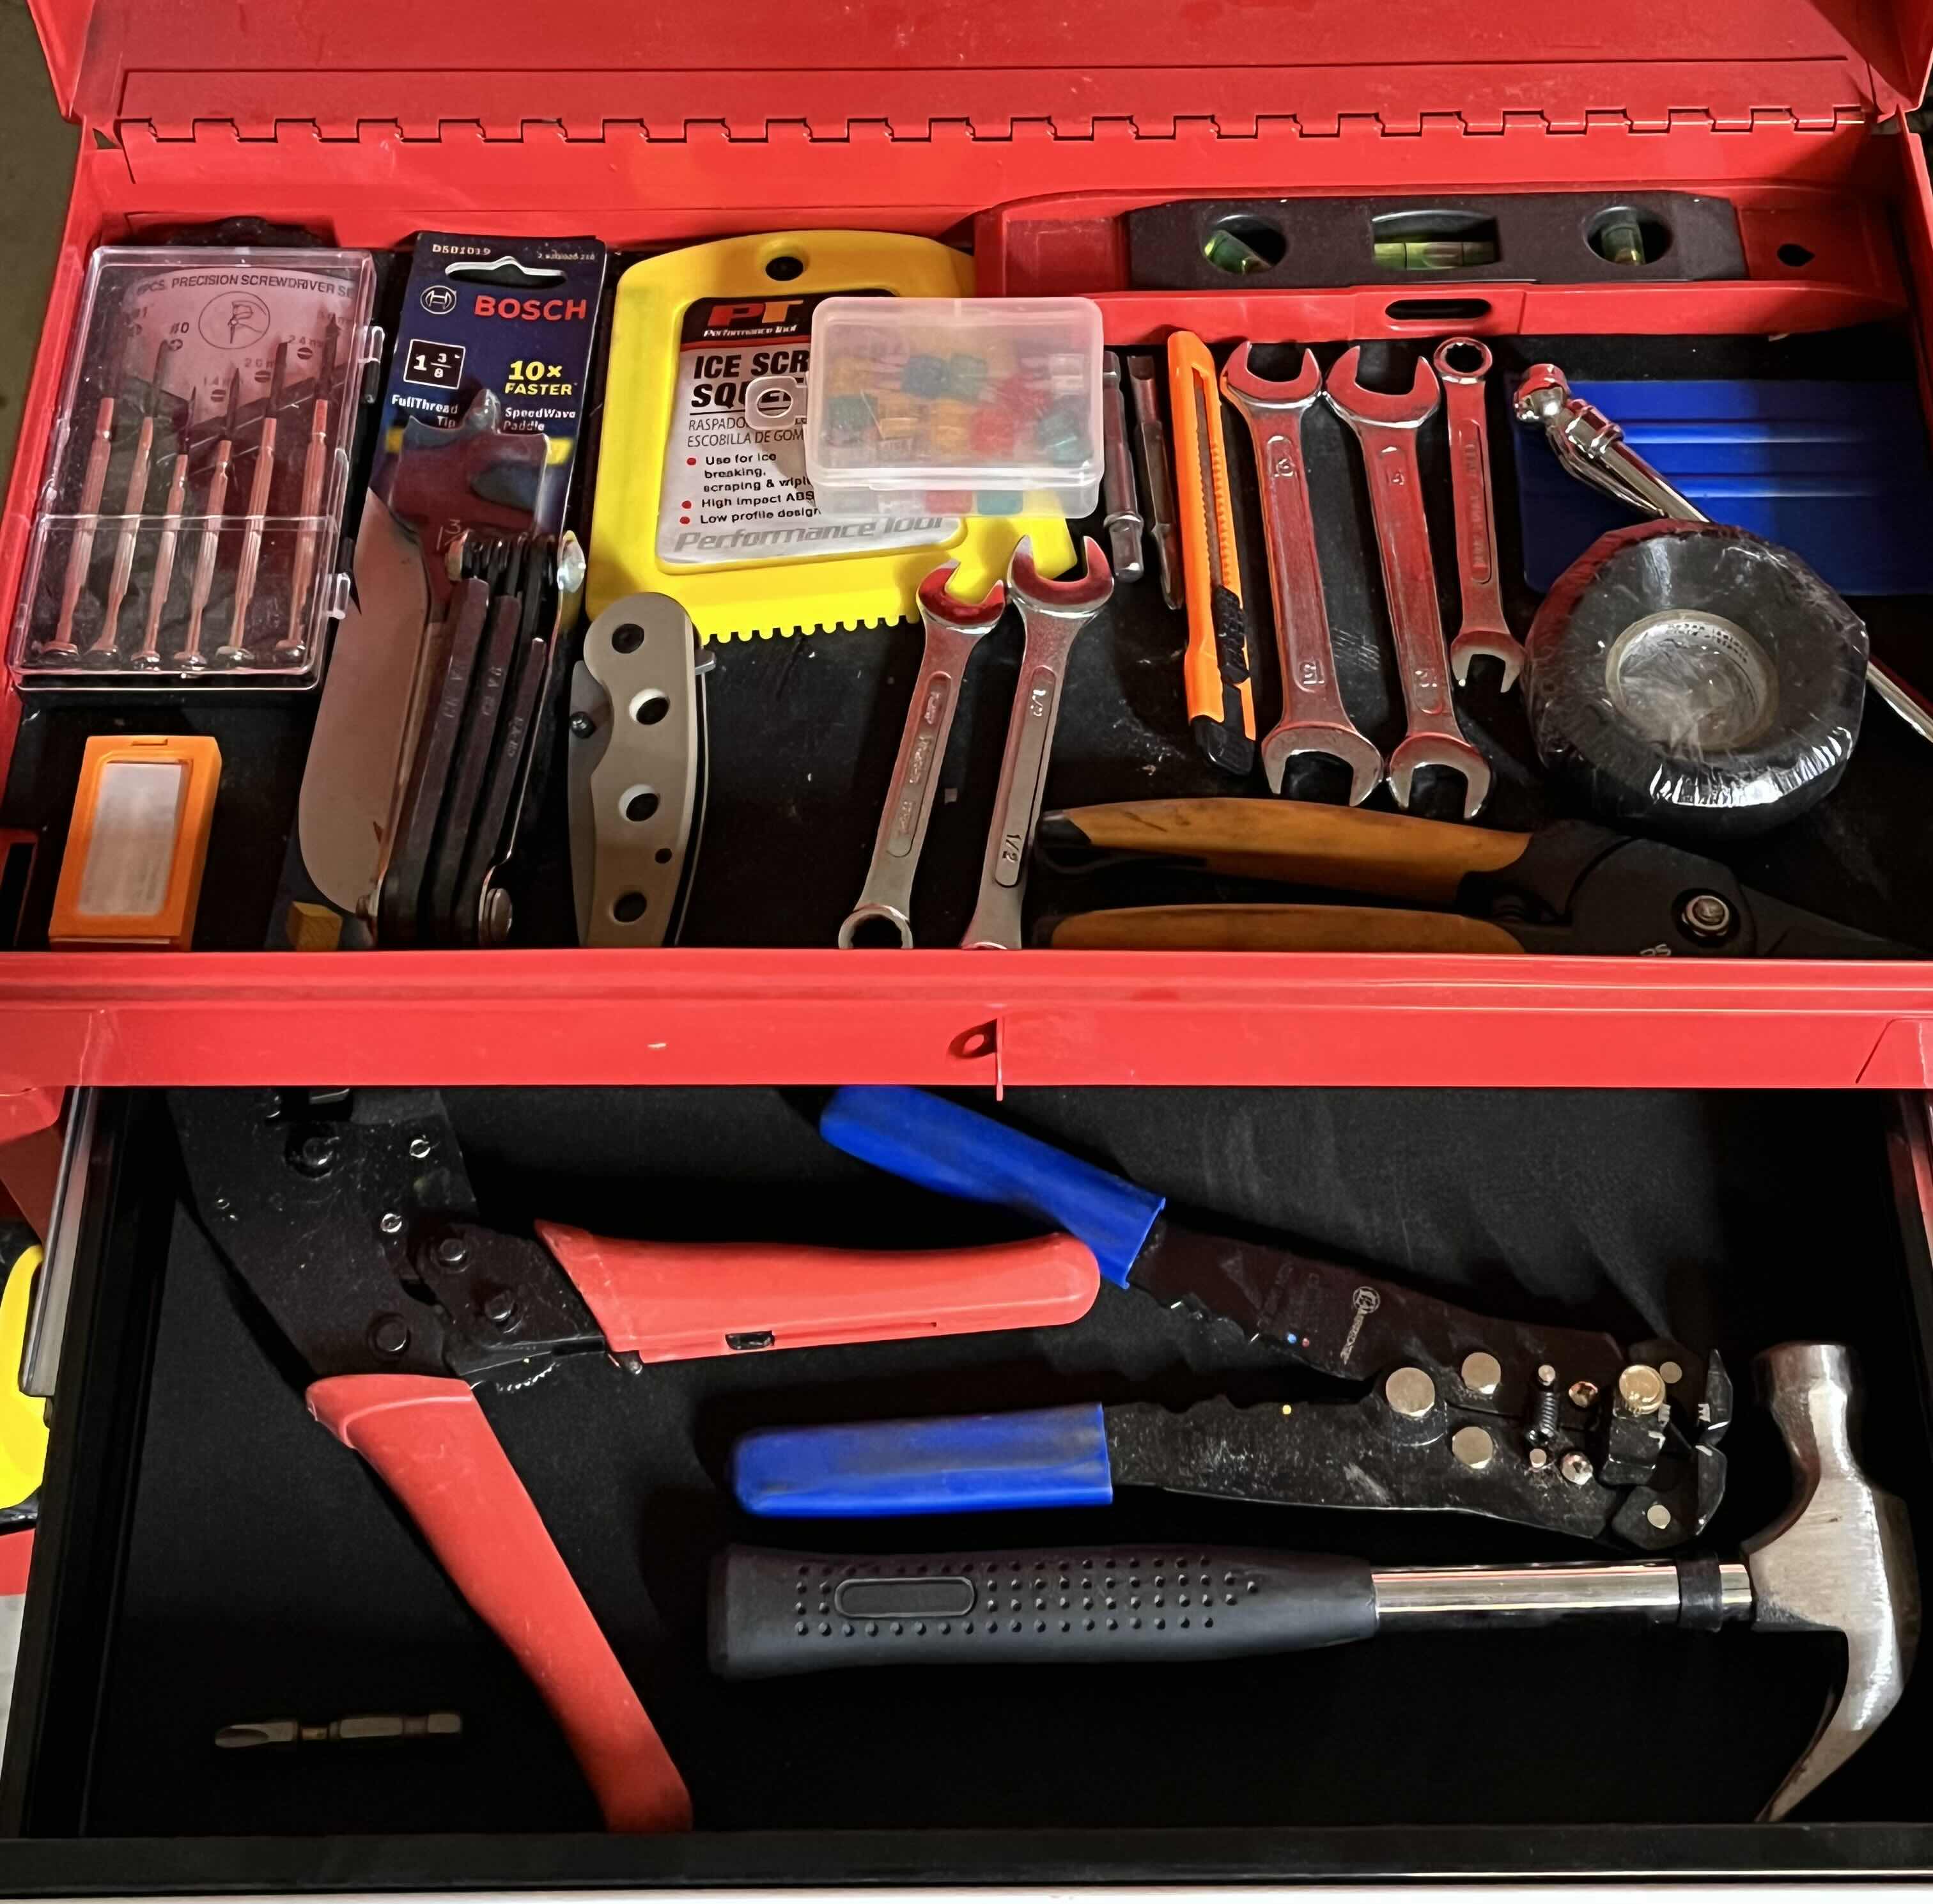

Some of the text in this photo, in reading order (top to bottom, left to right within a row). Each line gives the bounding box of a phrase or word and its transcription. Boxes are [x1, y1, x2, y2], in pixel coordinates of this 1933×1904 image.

[171, 275, 238, 287] PRECISION
[241, 275, 334, 294] SCREWDRIVER
[474, 295, 586, 321] BOSCH
[708, 300, 803, 327] PT
[704, 329, 772, 337] Performance
[694, 354, 741, 379] ICE
[391, 394, 458, 414] FullThread
[505, 407, 576, 419] SpeedWave
[437, 415, 456, 428] Tip
[503, 420, 545, 431] Paddle
[688, 432, 751, 448] ESCOBILLA
[755, 430, 771, 444] DE
[706, 456, 731, 465] Use
[735, 454, 753, 464] for
[704, 481, 761, 493] scraping
[766, 480, 774, 488] &
[702, 491, 814, 509] High impact ABS
[700, 515, 727, 524] Low
[731, 511, 773, 524] profile
[675, 520, 876, 552] Performance
[1002, 834, 1021, 863] 1/2
